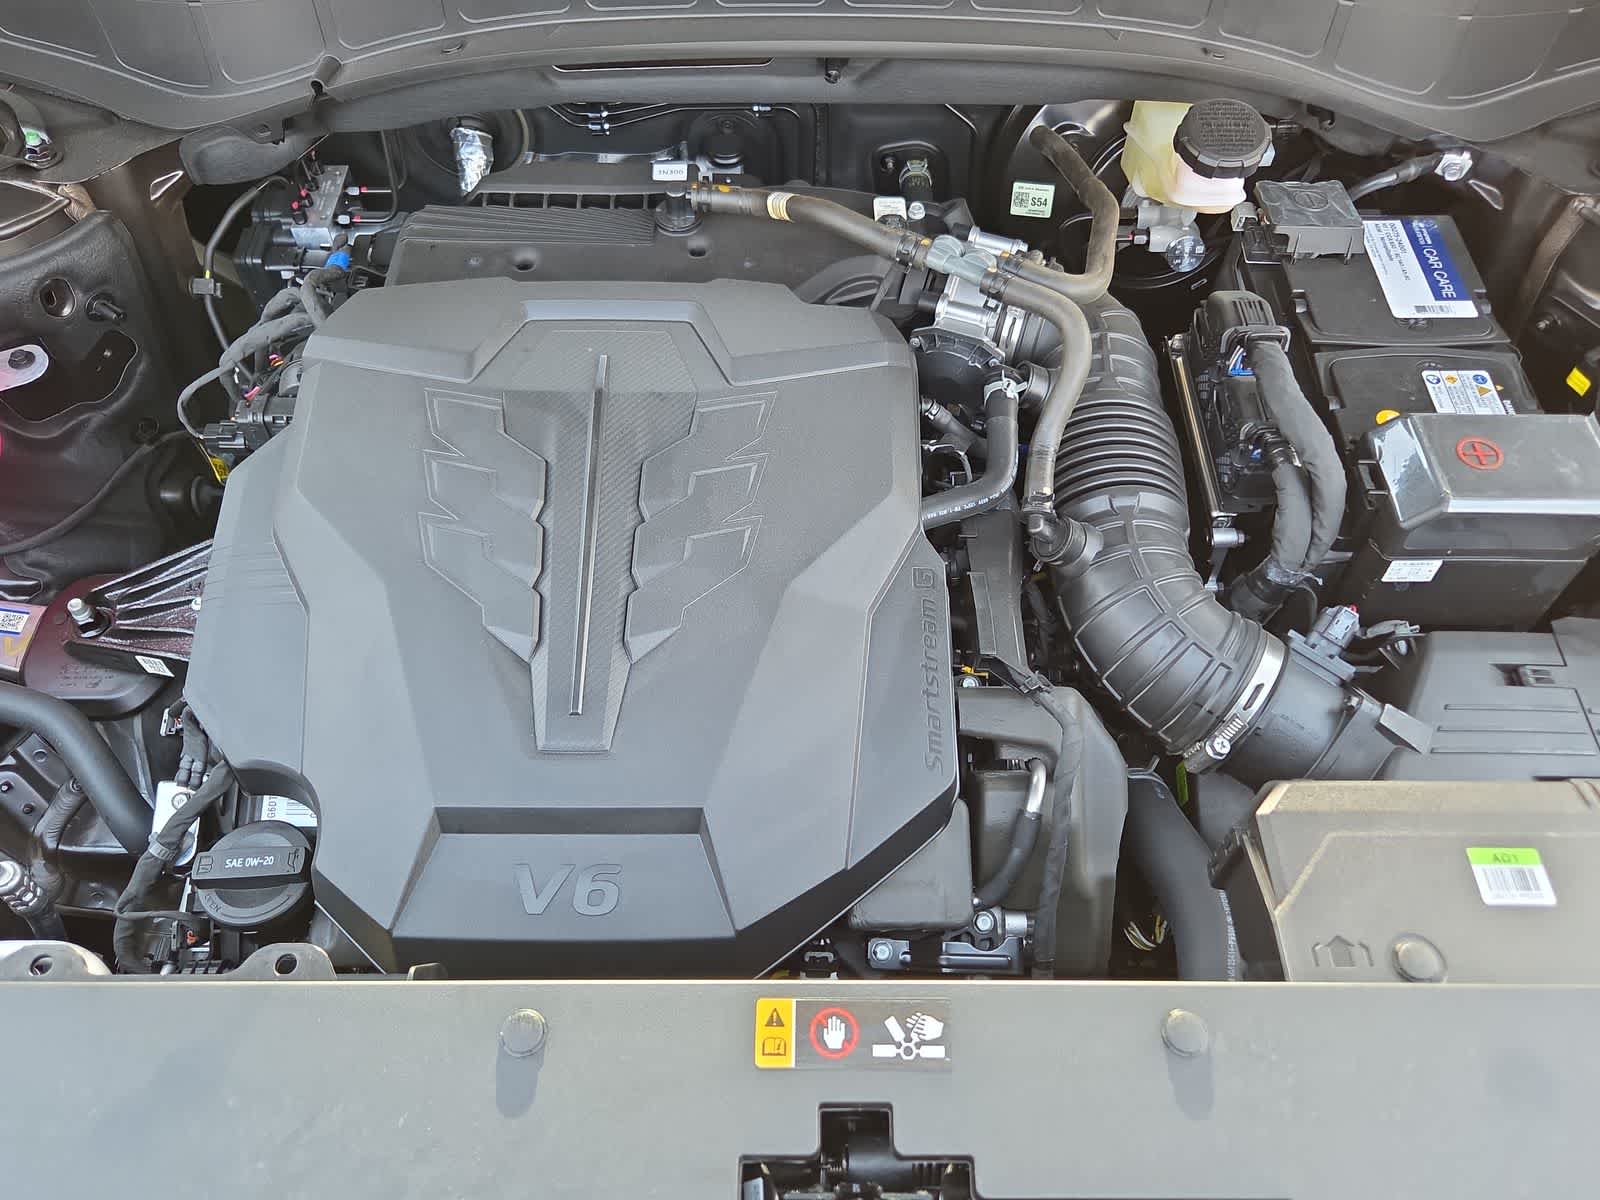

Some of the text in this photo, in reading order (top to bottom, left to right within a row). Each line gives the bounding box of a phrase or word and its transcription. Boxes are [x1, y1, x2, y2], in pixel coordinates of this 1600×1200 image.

[1030, 196, 1048, 207] S54
[1423, 247, 1457, 298] CAR CARE
[921, 598, 944, 777] Smartstream
[224, 855, 275, 868] SAE 0W-20
[512, 863, 622, 917] V6
